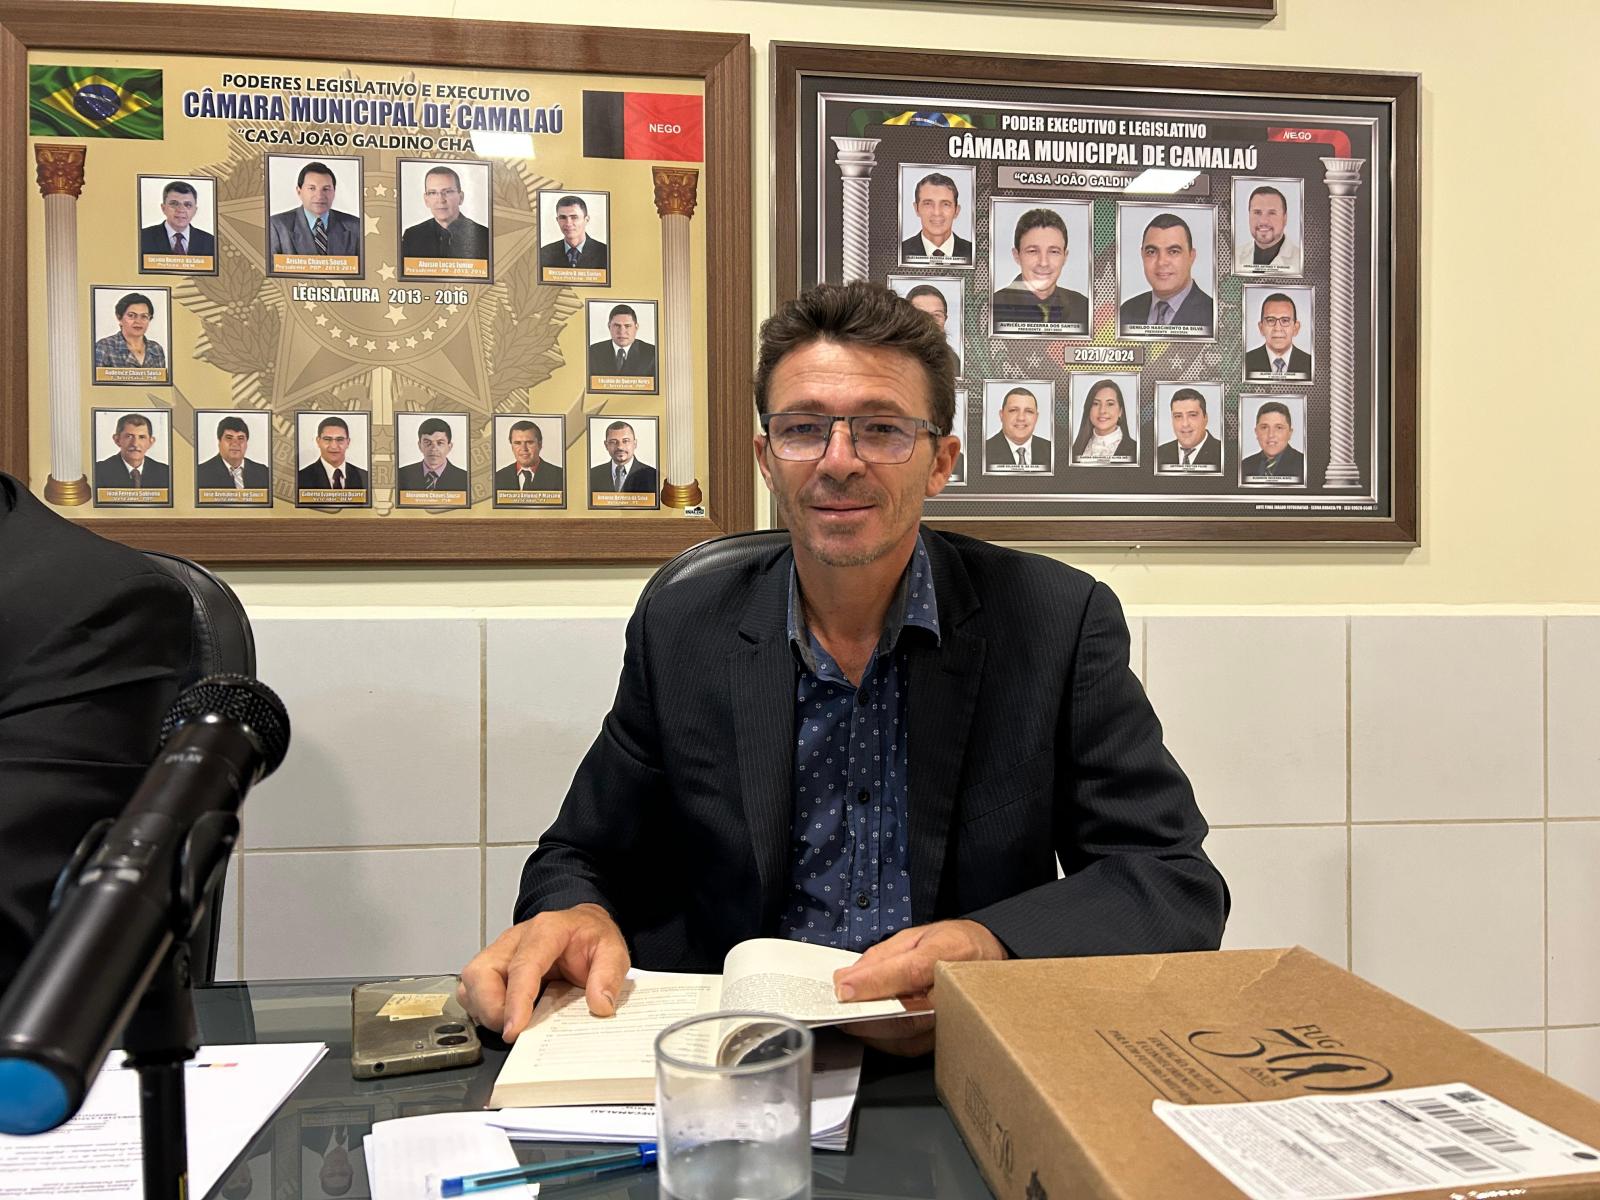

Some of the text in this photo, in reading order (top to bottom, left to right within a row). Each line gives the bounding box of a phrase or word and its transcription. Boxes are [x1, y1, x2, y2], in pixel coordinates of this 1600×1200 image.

[223, 74, 530, 102] PODERES LEGISLATIVO E EXECUTIVO
[183, 87, 564, 134] CÂMARA MUNICIPAL DE CAMALAÚ
[649, 123, 682, 134] NEGO
[1002, 115, 1207, 139] PODER EXECUTIVO E LEGISLATIVO
[1283, 131, 1312, 141] NEGO
[297, 129, 348, 146] JOÃO
[352, 134, 434, 150] GALDINO
[948, 132, 1258, 170] CÂMARA MUNICIPAL DE CAMALAÚ
[1054, 172, 1086, 186] JOÃO
[1089, 175, 1131, 188] GALDIN
[292, 286, 380, 303] LEGISLATURA
[388, 289, 421, 304] 2013
[434, 290, 468, 305] 2016
[1074, 349, 1135, 363] 2021/2024
[1292, 1024, 1345, 1050] FUG
